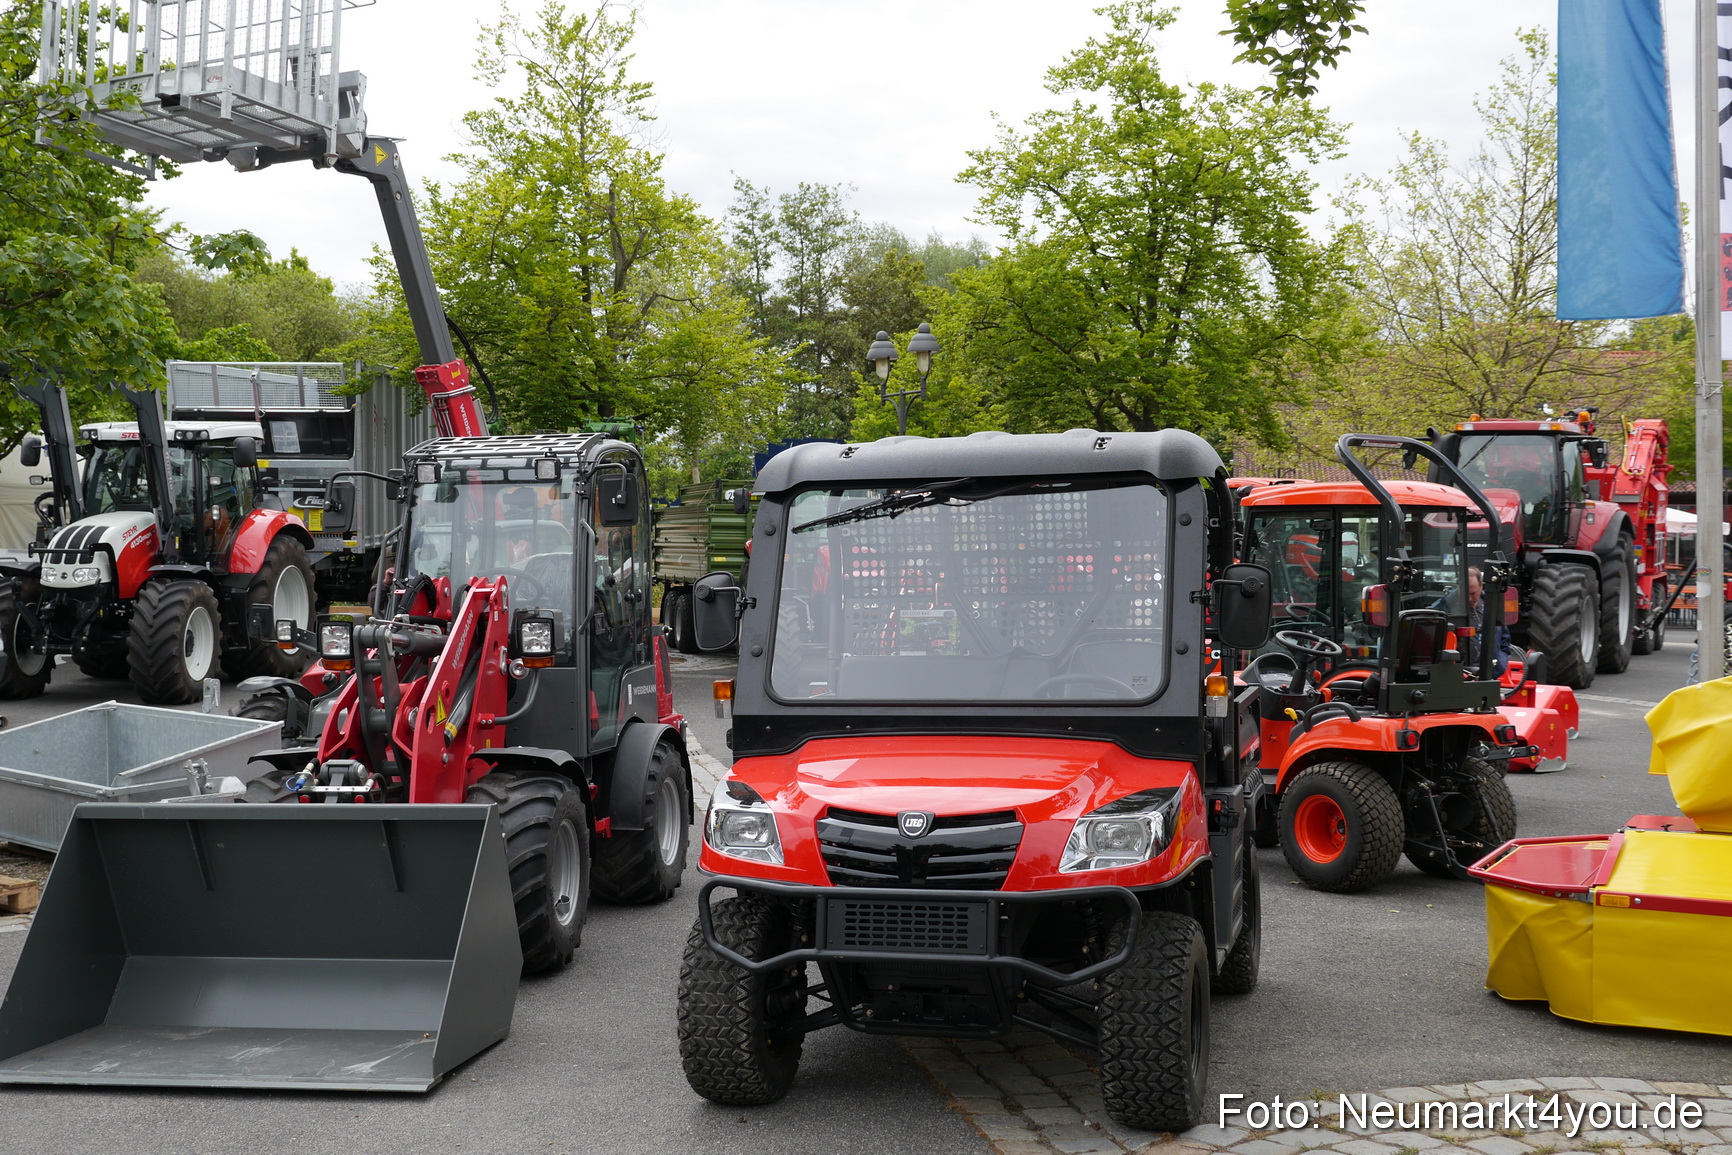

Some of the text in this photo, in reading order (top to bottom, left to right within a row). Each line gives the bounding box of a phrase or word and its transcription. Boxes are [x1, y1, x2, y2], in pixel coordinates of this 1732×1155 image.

[121, 525, 138, 541] STEYR
[452, 609, 474, 670] WEIDEMANN
[633, 684, 657, 696] WEIDEMANN
[905, 818, 924, 828] LTEC
